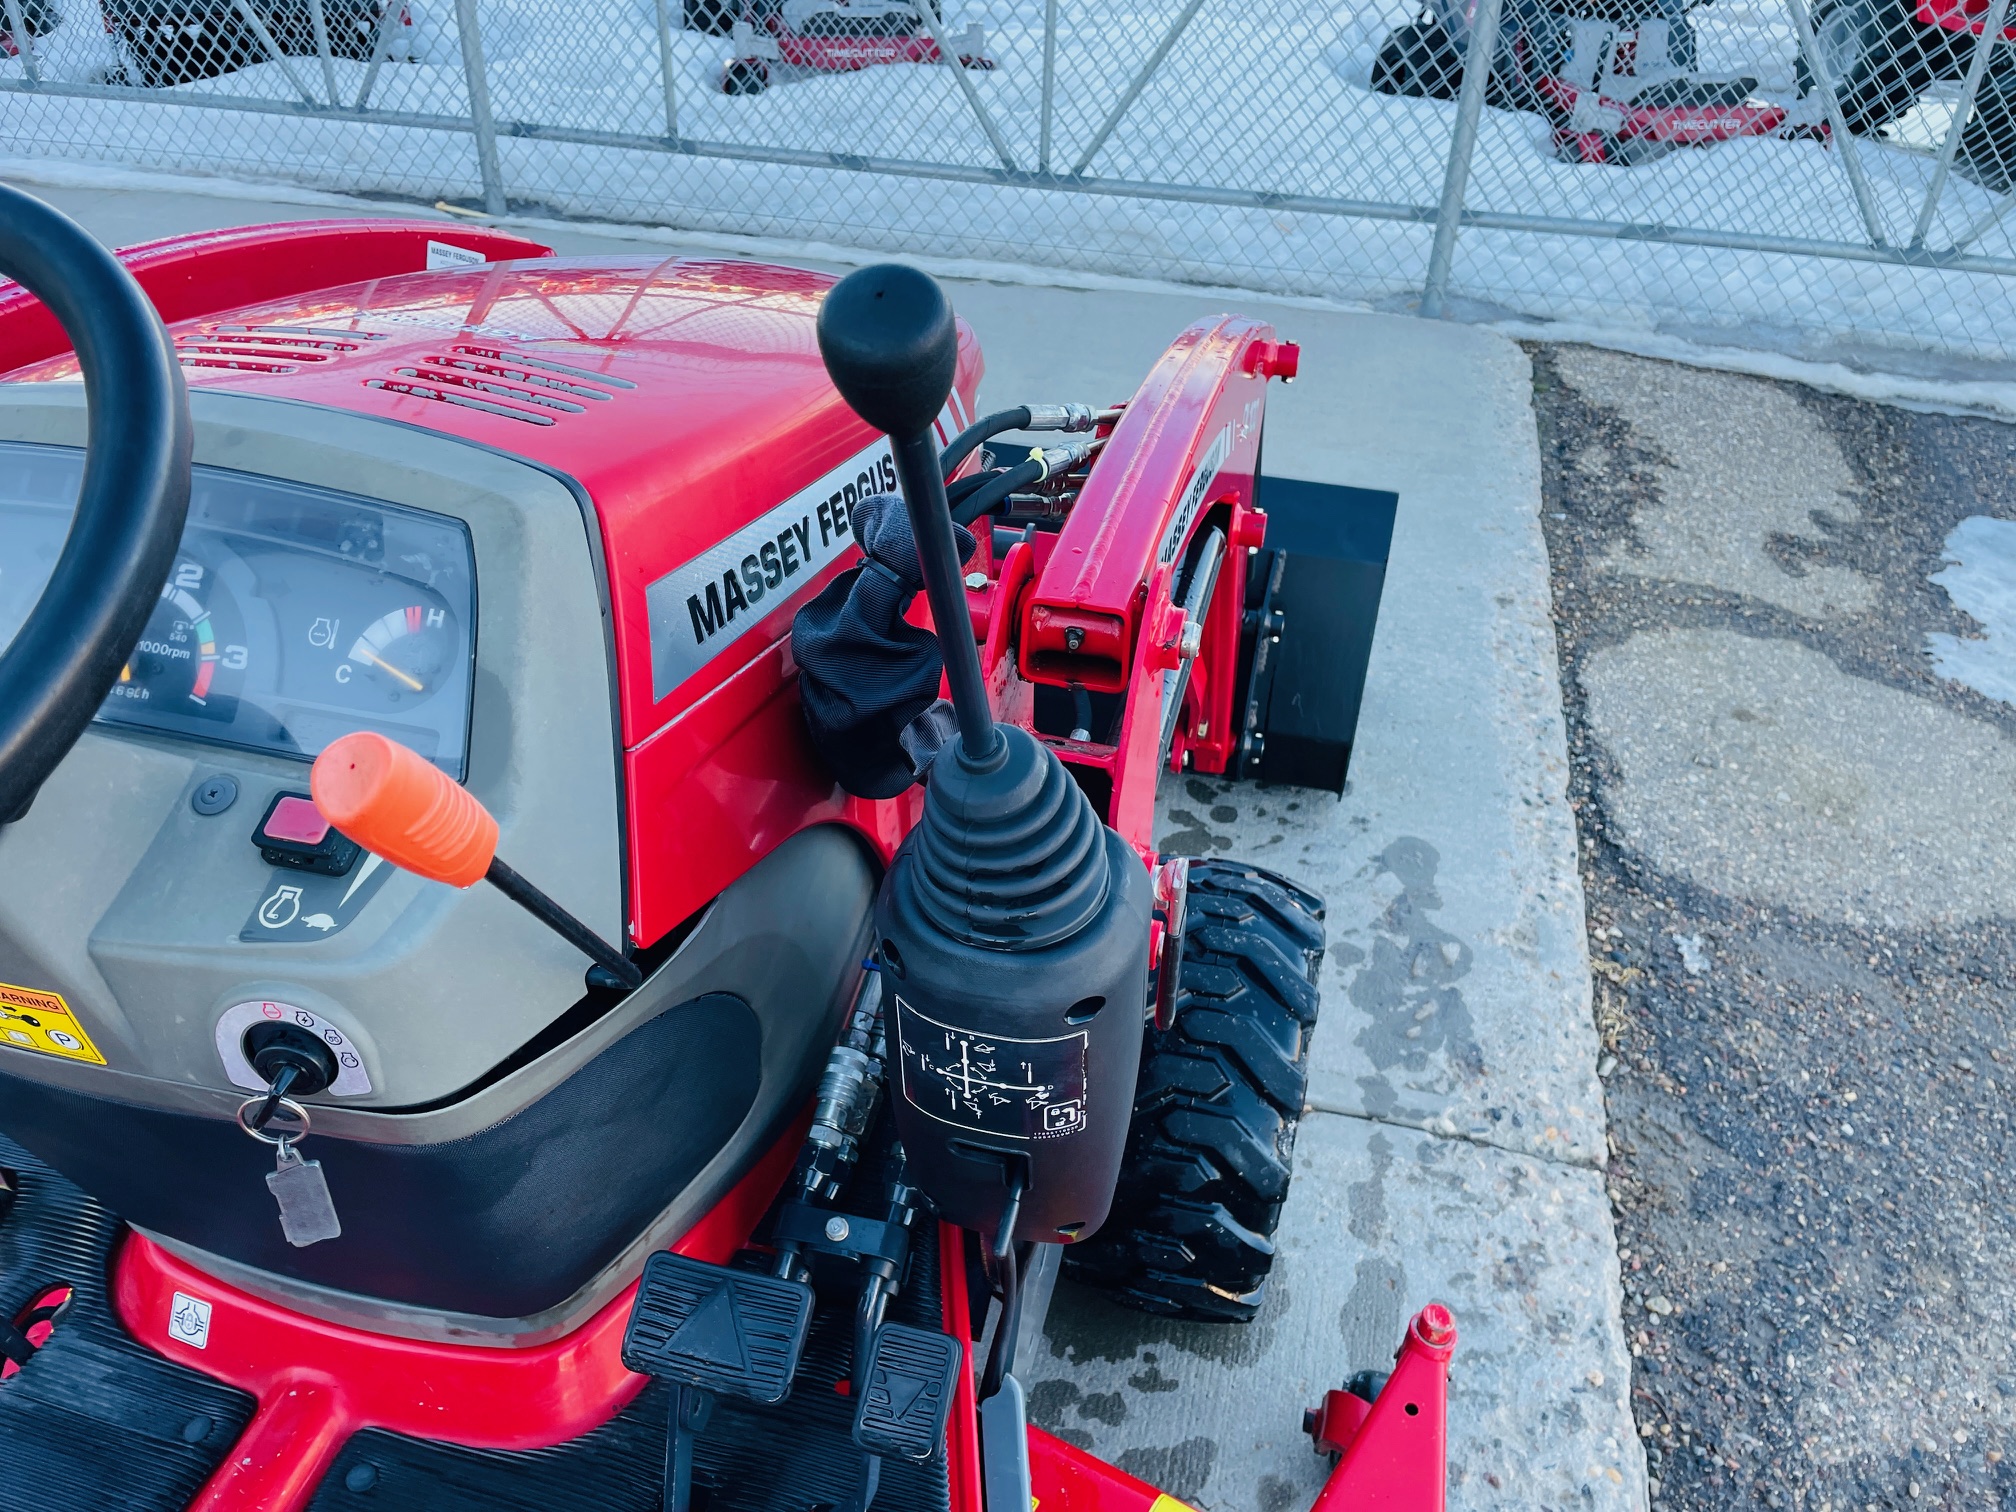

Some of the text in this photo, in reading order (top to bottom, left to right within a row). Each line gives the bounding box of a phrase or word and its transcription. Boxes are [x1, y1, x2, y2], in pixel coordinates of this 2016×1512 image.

[431, 246, 452, 258] MASSEY
[685, 453, 903, 646] MASSEY FERGUS
[175, 564, 204, 589] 2
[427, 607, 445, 628] H
[168, 632, 188, 643] 540
[222, 644, 249, 670] 3
[335, 664, 351, 684] C
[0, 992, 60, 1010] ARNING
